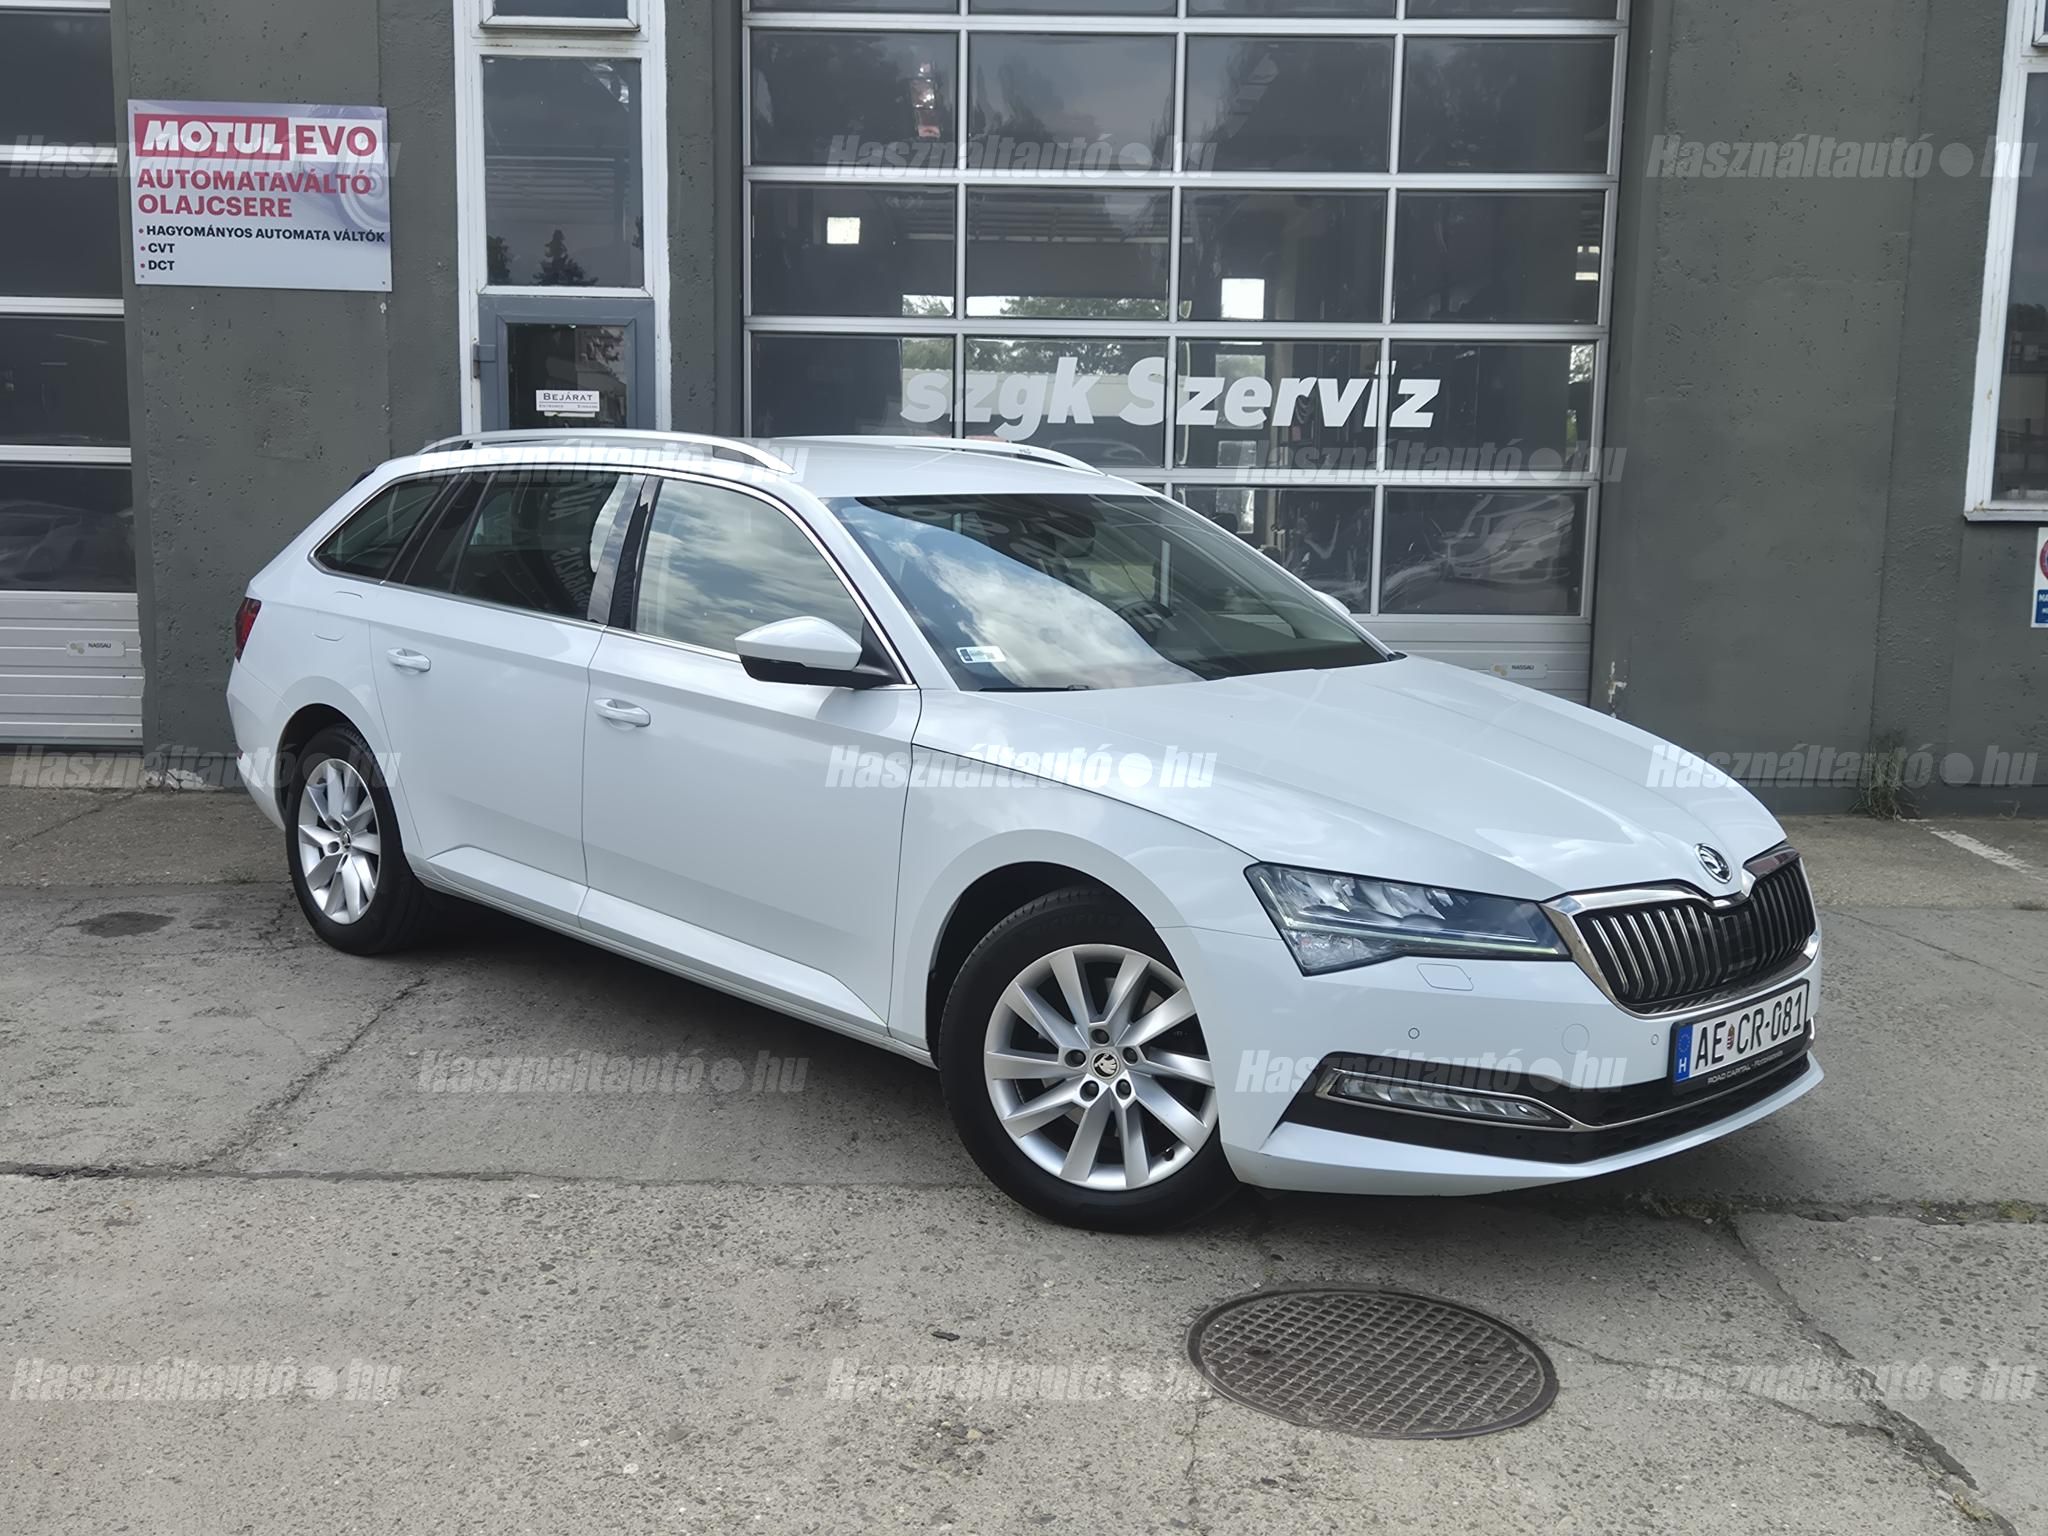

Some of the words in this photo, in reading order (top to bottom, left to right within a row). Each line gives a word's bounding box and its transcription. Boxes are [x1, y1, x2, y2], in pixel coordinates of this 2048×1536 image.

[143, 121, 283, 154] MOTUL
[296, 125, 377, 156] EVO
[137, 169, 372, 194] AUTOMATAVÁLTÓ
[138, 194, 293, 217] OLAJCSERE
[146, 224, 253, 238] HAGYOMÁNYOS
[255, 228, 331, 241] AUTOMATA
[333, 229, 386, 243] VÁLTÓK
[148, 243, 176, 254] CVT
[148, 260, 176, 271] DCT
[900, 357, 1101, 440] szgk
[1119, 357, 1441, 428] Szerviz
[1695, 1020, 1727, 1070] AE
[1736, 991, 1803, 1055] CR-081
[1678, 1057, 1688, 1074] H
